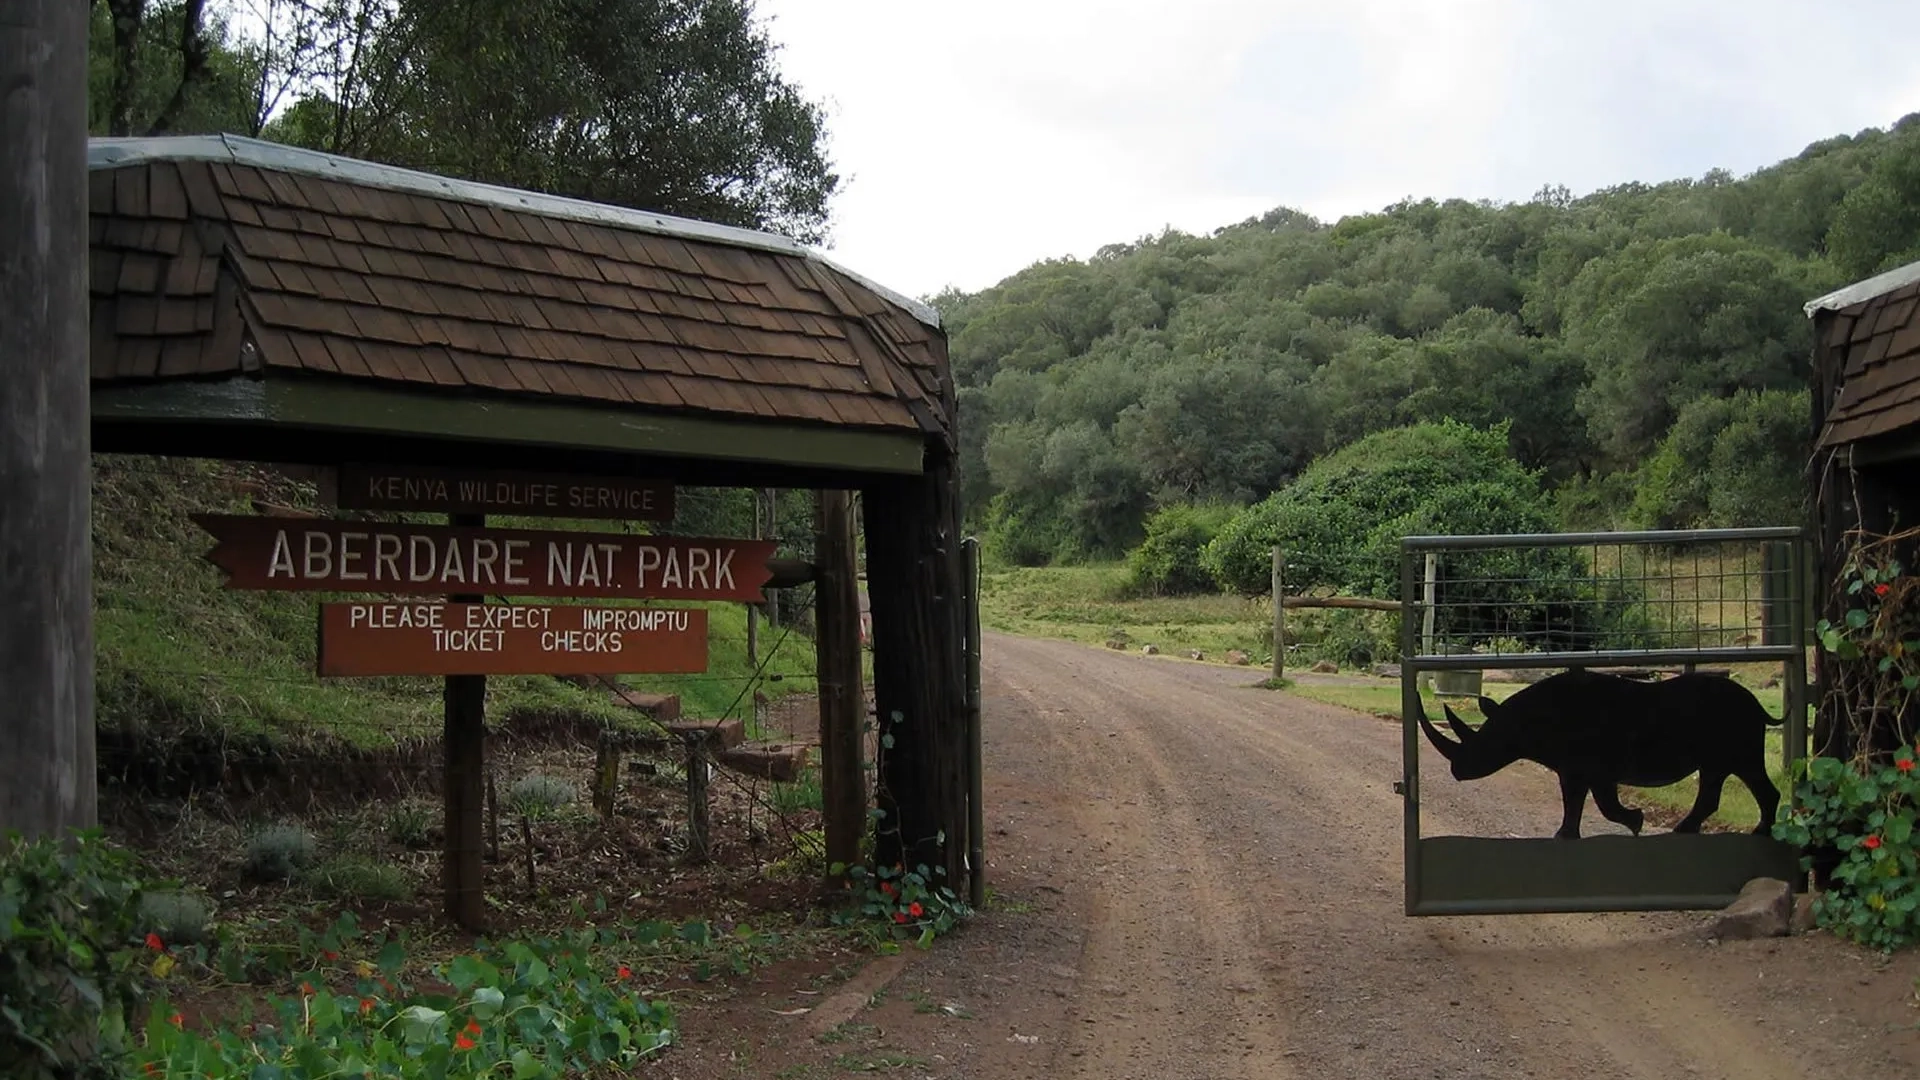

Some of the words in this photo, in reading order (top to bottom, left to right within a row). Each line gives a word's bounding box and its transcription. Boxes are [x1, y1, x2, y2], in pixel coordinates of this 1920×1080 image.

[368, 476, 448, 501] KENYA
[459, 481, 556, 505] WILDLIFE
[568, 487, 654, 510] SERVICE
[267, 529, 530, 586] ABERDARE
[638, 547, 736, 590] PARK
[350, 605, 444, 629] PLEASE
[466, 607, 551, 629] EXPECT
[583, 609, 689, 632] IMPROMPTU
[433, 629, 505, 652] TICKET
[541, 630, 622, 653] CHECKS
